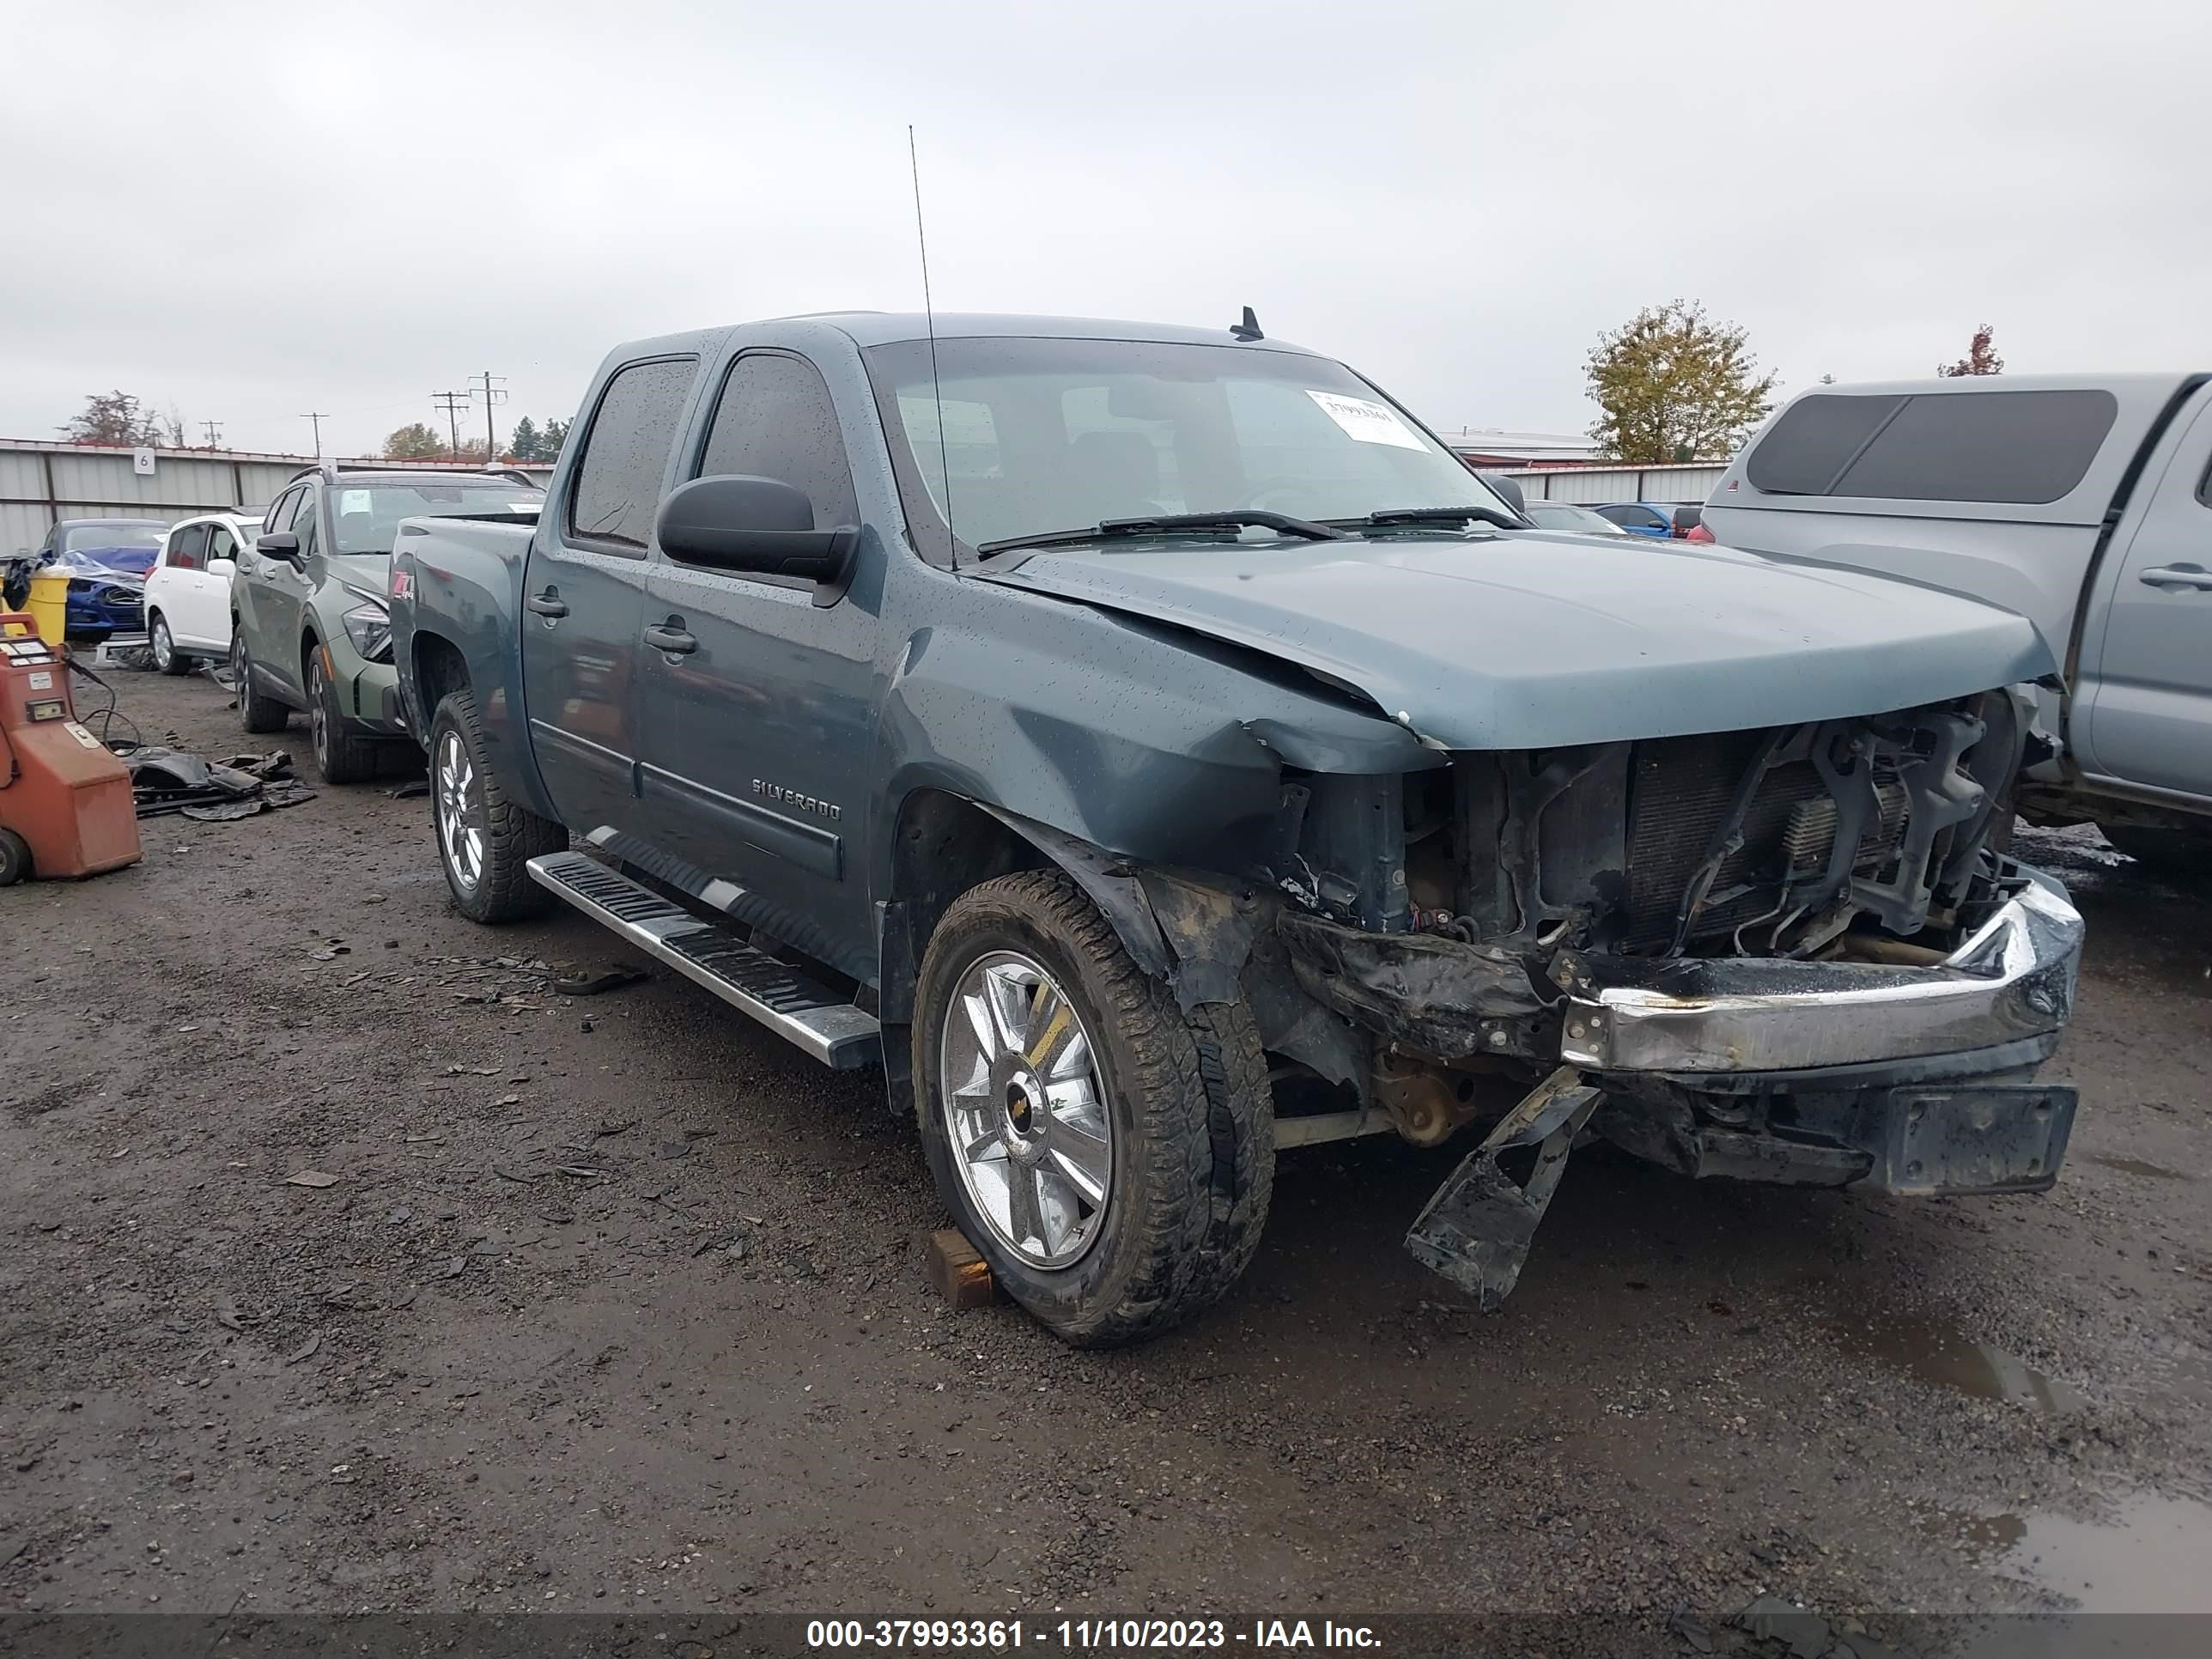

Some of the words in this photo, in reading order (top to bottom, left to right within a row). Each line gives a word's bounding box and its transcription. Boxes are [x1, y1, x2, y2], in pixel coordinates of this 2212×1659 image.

[1325, 401, 1393, 422] 37993361
[141, 455, 149, 466] 6
[752, 778, 842, 820] SILVERADO
